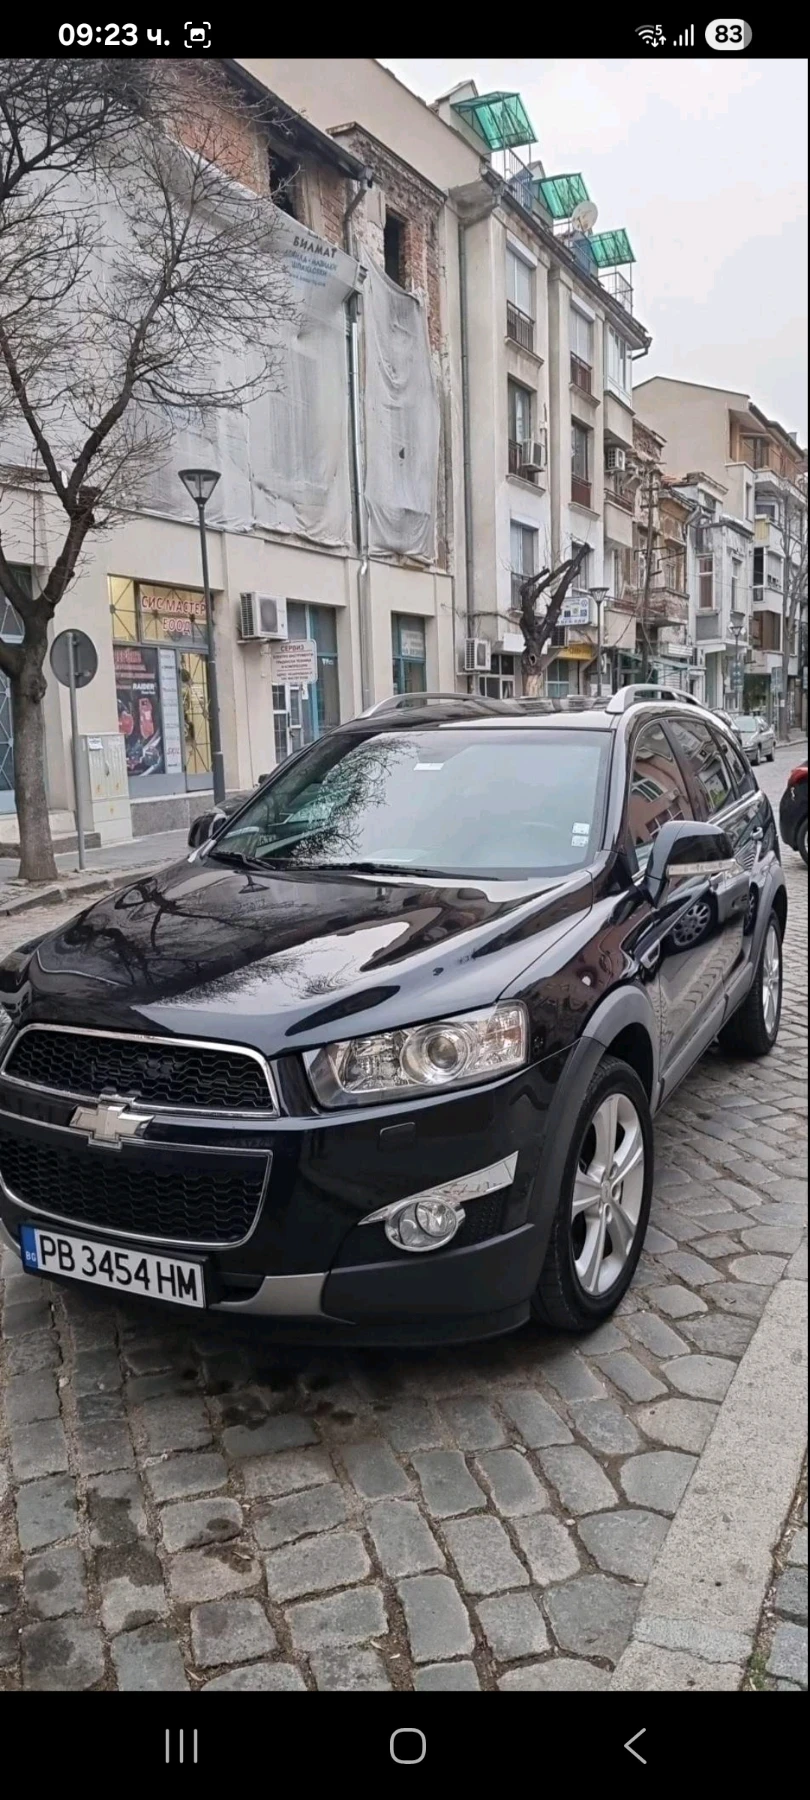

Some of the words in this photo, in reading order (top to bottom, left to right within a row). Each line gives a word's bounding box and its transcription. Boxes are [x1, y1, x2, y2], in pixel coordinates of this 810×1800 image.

[293, 236, 337, 258] БИЛМАТ
[141, 595, 163, 610] СИС
[165, 599, 206, 616] МАСТЕР
[162, 617, 191, 636] ЕООД
[25, 1250, 37, 1262] BG
[39, 1234, 75, 1271] PB
[82, 1245, 150, 1291] 3454
[156, 1260, 198, 1301] HM
